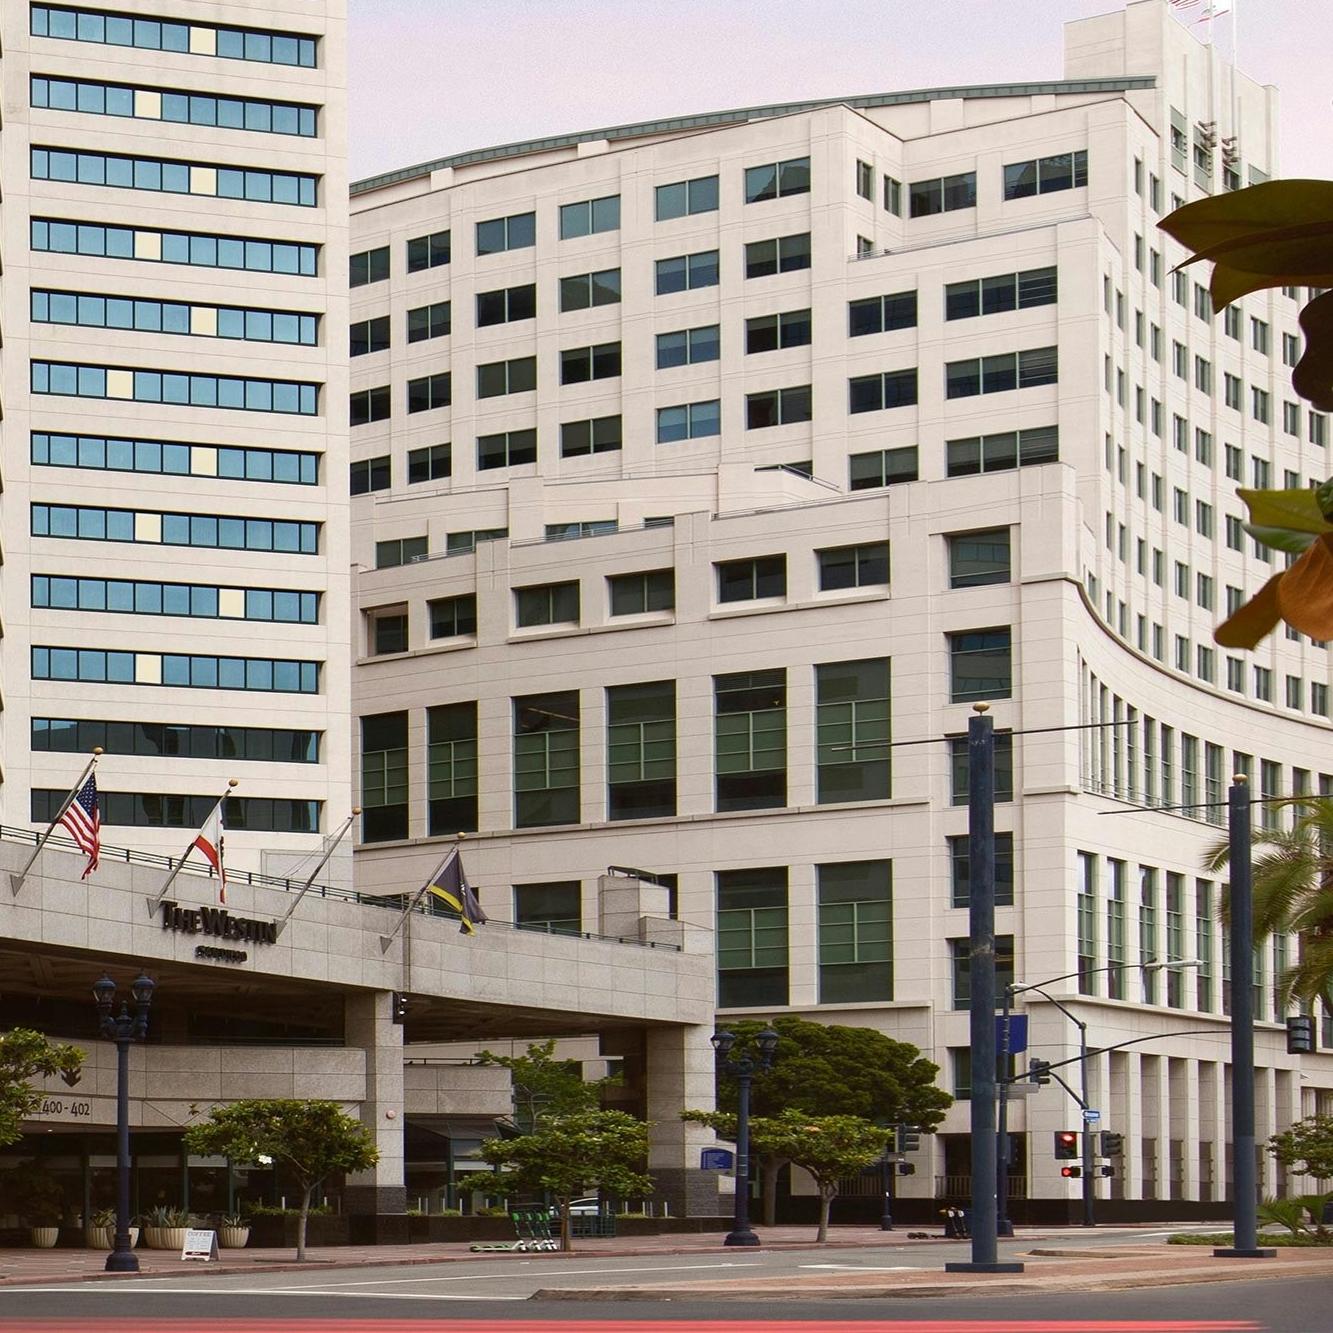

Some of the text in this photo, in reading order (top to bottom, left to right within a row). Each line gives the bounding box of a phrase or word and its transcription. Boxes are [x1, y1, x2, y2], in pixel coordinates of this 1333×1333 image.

[159, 899, 277, 945] THE WESTIN
[42, 1100, 63, 1115] 400
[71, 1102, 90, 1117] 402
